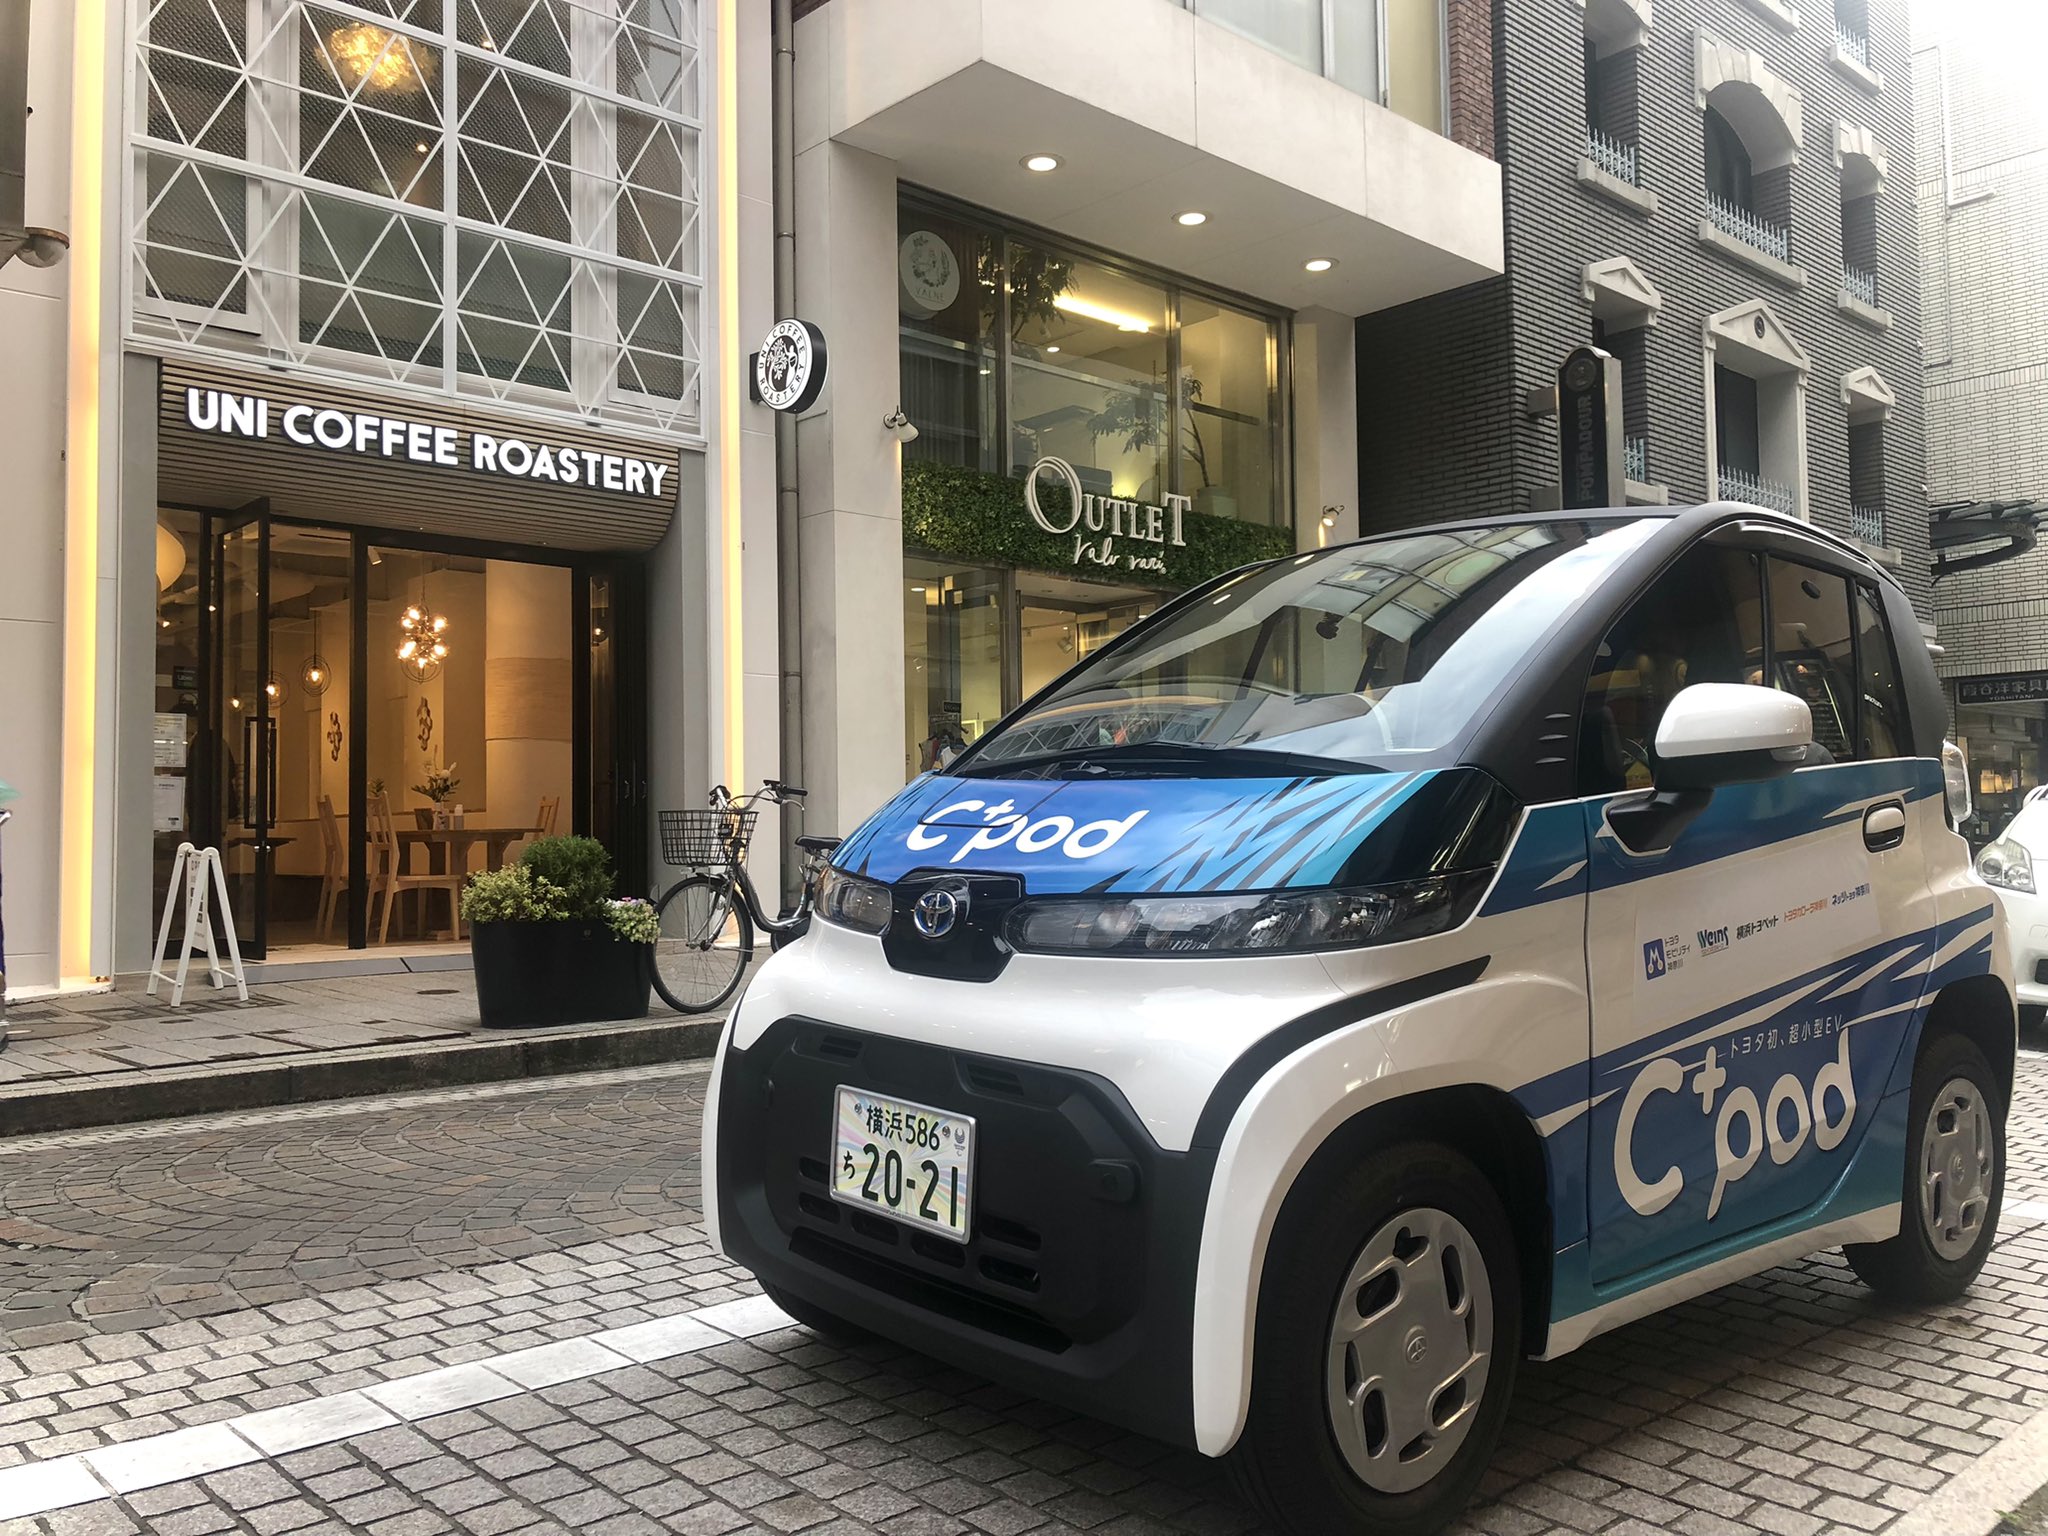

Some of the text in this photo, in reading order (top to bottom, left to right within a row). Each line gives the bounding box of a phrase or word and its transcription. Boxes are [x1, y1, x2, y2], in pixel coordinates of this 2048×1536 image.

[759, 325, 806, 369] UNI COFFEE
[760, 364, 805, 403] ROASTERY
[186, 387, 669, 496] UNI COFFEE ROASTERY
[1578, 395, 1594, 502] POMPADOUR
[1025, 456, 1192, 547] OUTLET
[1963, 680, 2048, 696] 谷洋家具
[1665, 935, 1679, 948] トヨタ
[1736, 915, 1779, 941] 横浜トヨペット
[843, 1142, 959, 1228] ち 20-21
